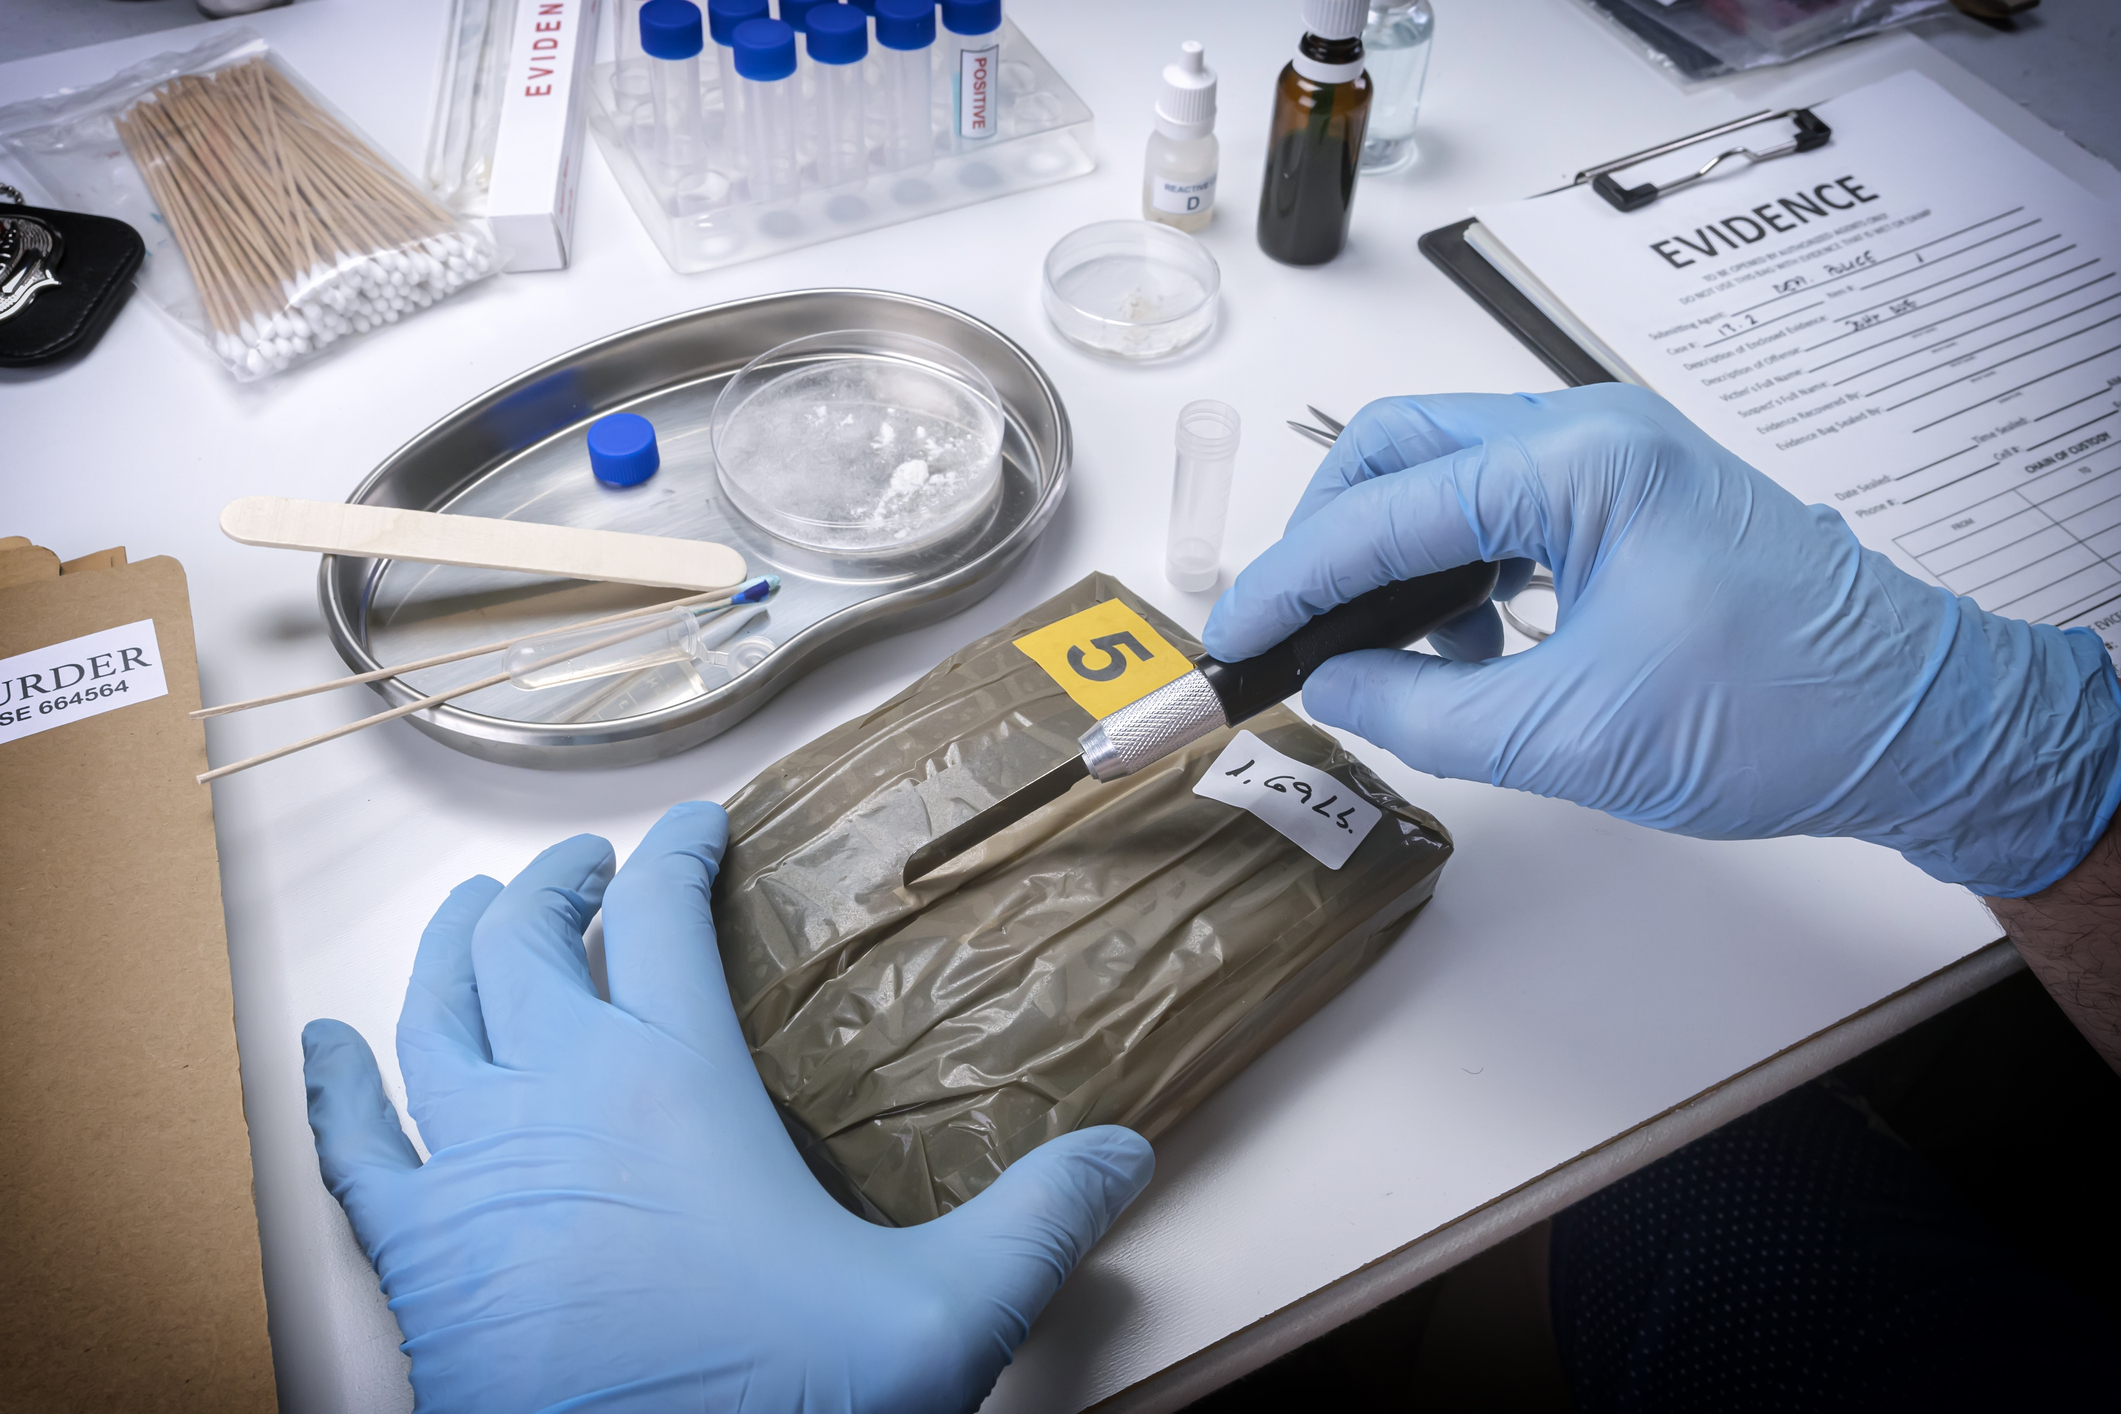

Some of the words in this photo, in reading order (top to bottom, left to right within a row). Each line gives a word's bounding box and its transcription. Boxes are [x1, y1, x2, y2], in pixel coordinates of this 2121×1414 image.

[972, 57, 988, 130] POSITIVE
[1187, 196, 1200, 210] D
[1649, 175, 1880, 269] EVIDENCE
[2024, 457, 2056, 474] CHAIN
[2053, 450, 2069, 461] OF
[2068, 431, 2112, 455] CUSTODY
[1066, 630, 1155, 683] 5
[38, 679, 130, 715] 664564
